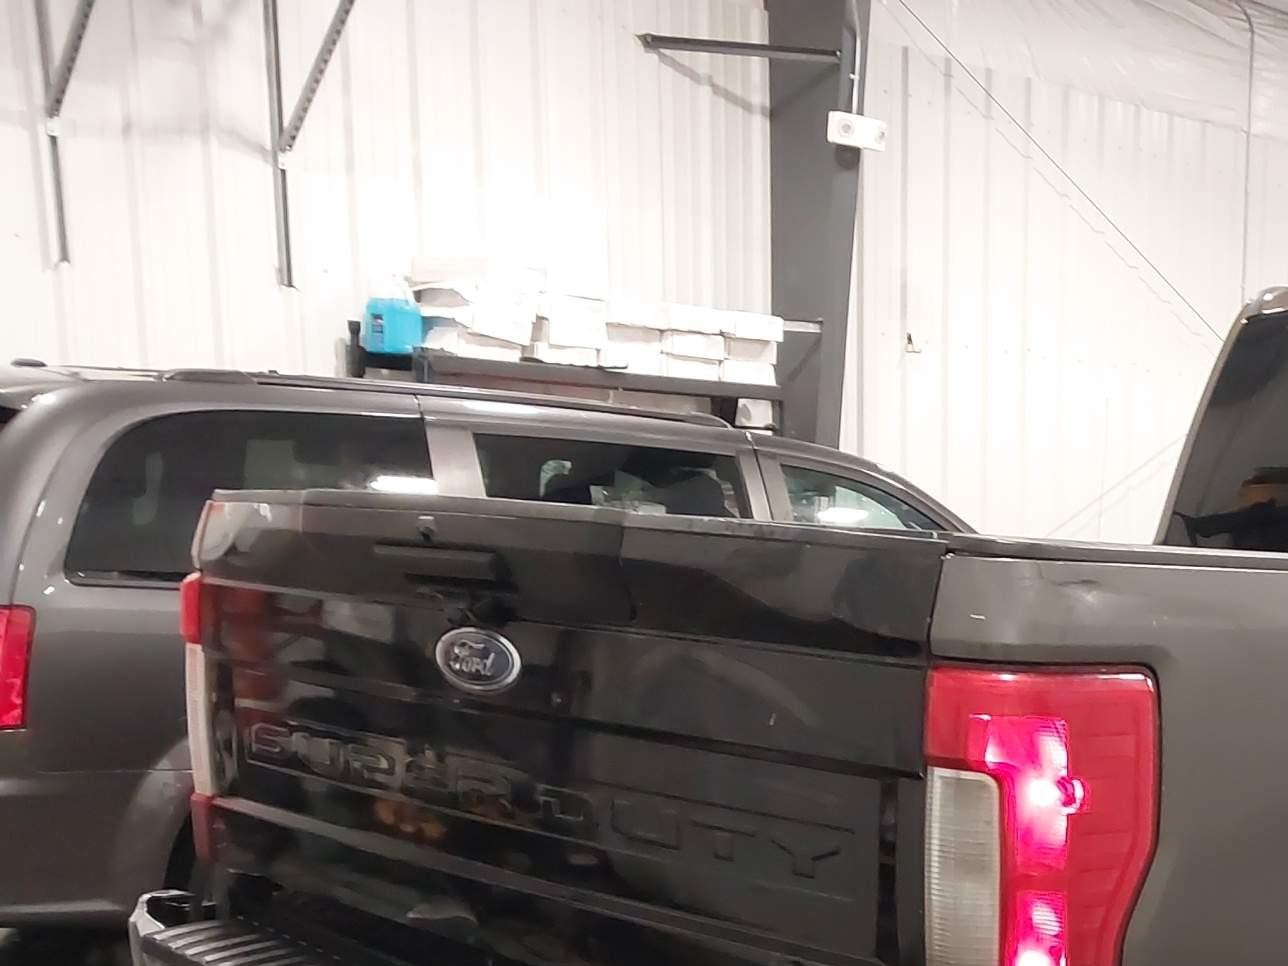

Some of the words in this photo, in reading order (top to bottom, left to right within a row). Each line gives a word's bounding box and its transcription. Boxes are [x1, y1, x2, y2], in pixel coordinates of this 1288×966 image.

[448, 639, 496, 676] Ford
[249, 721, 519, 817] SUPER
[534, 783, 844, 880] DUTY
